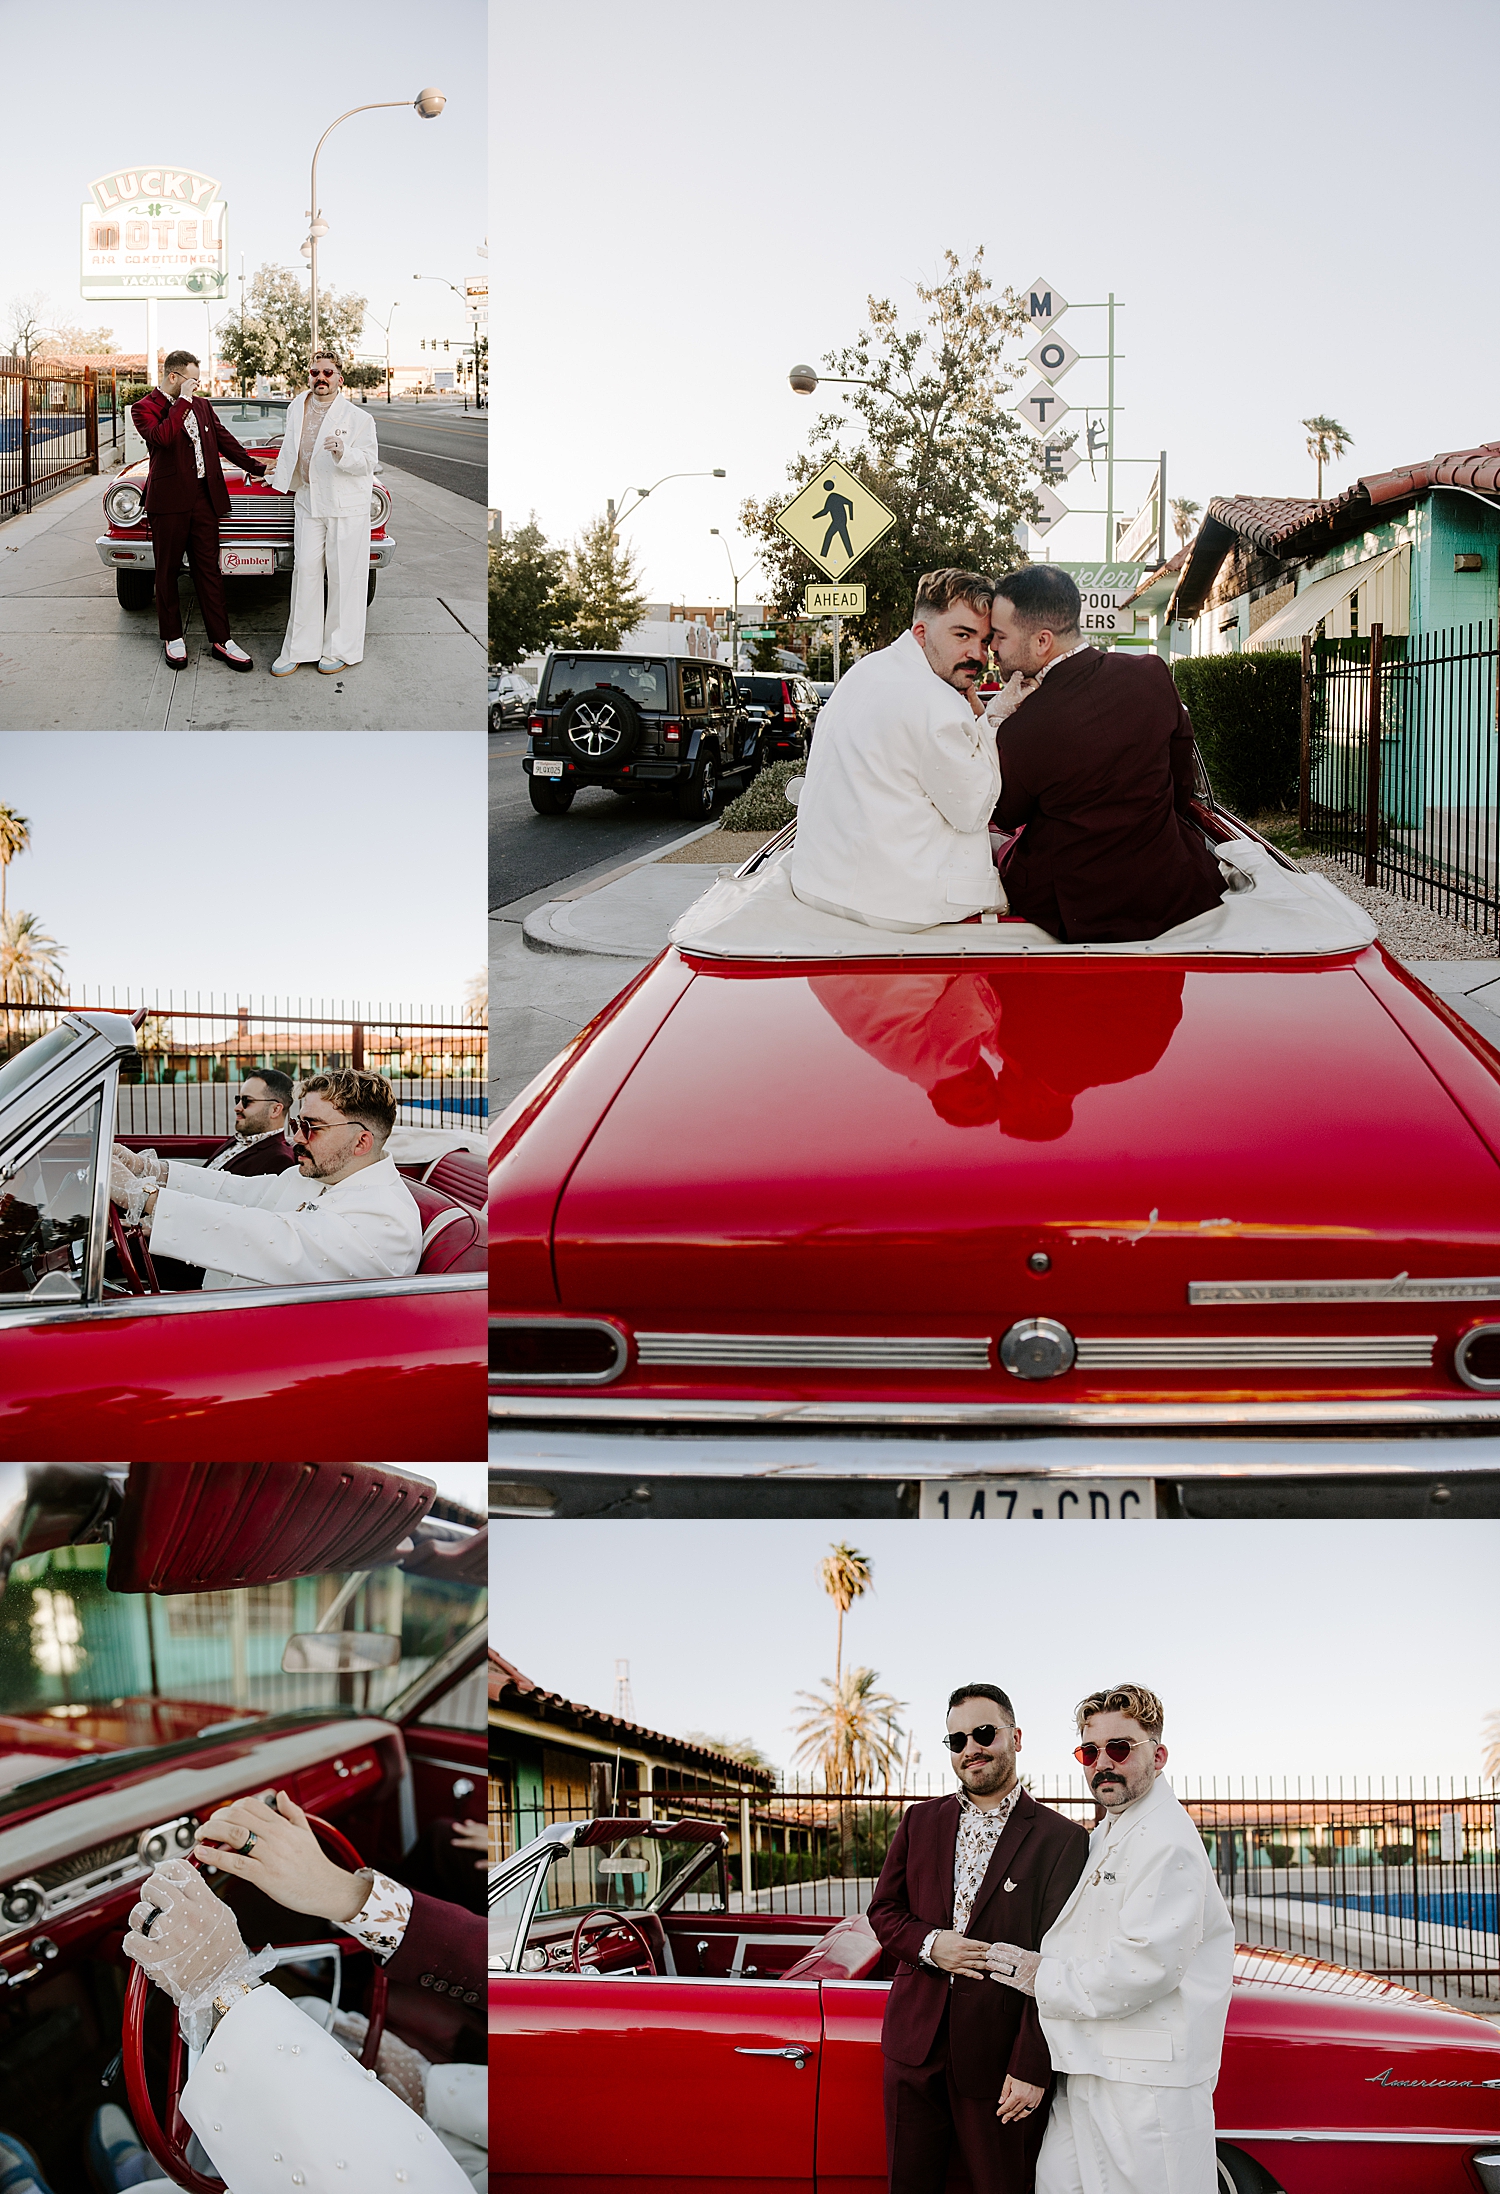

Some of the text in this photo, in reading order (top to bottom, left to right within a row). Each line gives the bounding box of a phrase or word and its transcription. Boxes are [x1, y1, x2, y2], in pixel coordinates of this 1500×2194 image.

[95, 170, 216, 210] LUCKY
[88, 219, 222, 250] MOTEL
[92, 255, 215, 265] AIR CONDITIONED
[121, 276, 184, 286] VACANCY
[1030, 291, 1065, 523] MOTEL
[226, 555, 270, 567] Rambler
[1070, 565, 1140, 589] velers
[813, 593, 858, 606] AHEAD
[1364, 2067, 1474, 2088] American
